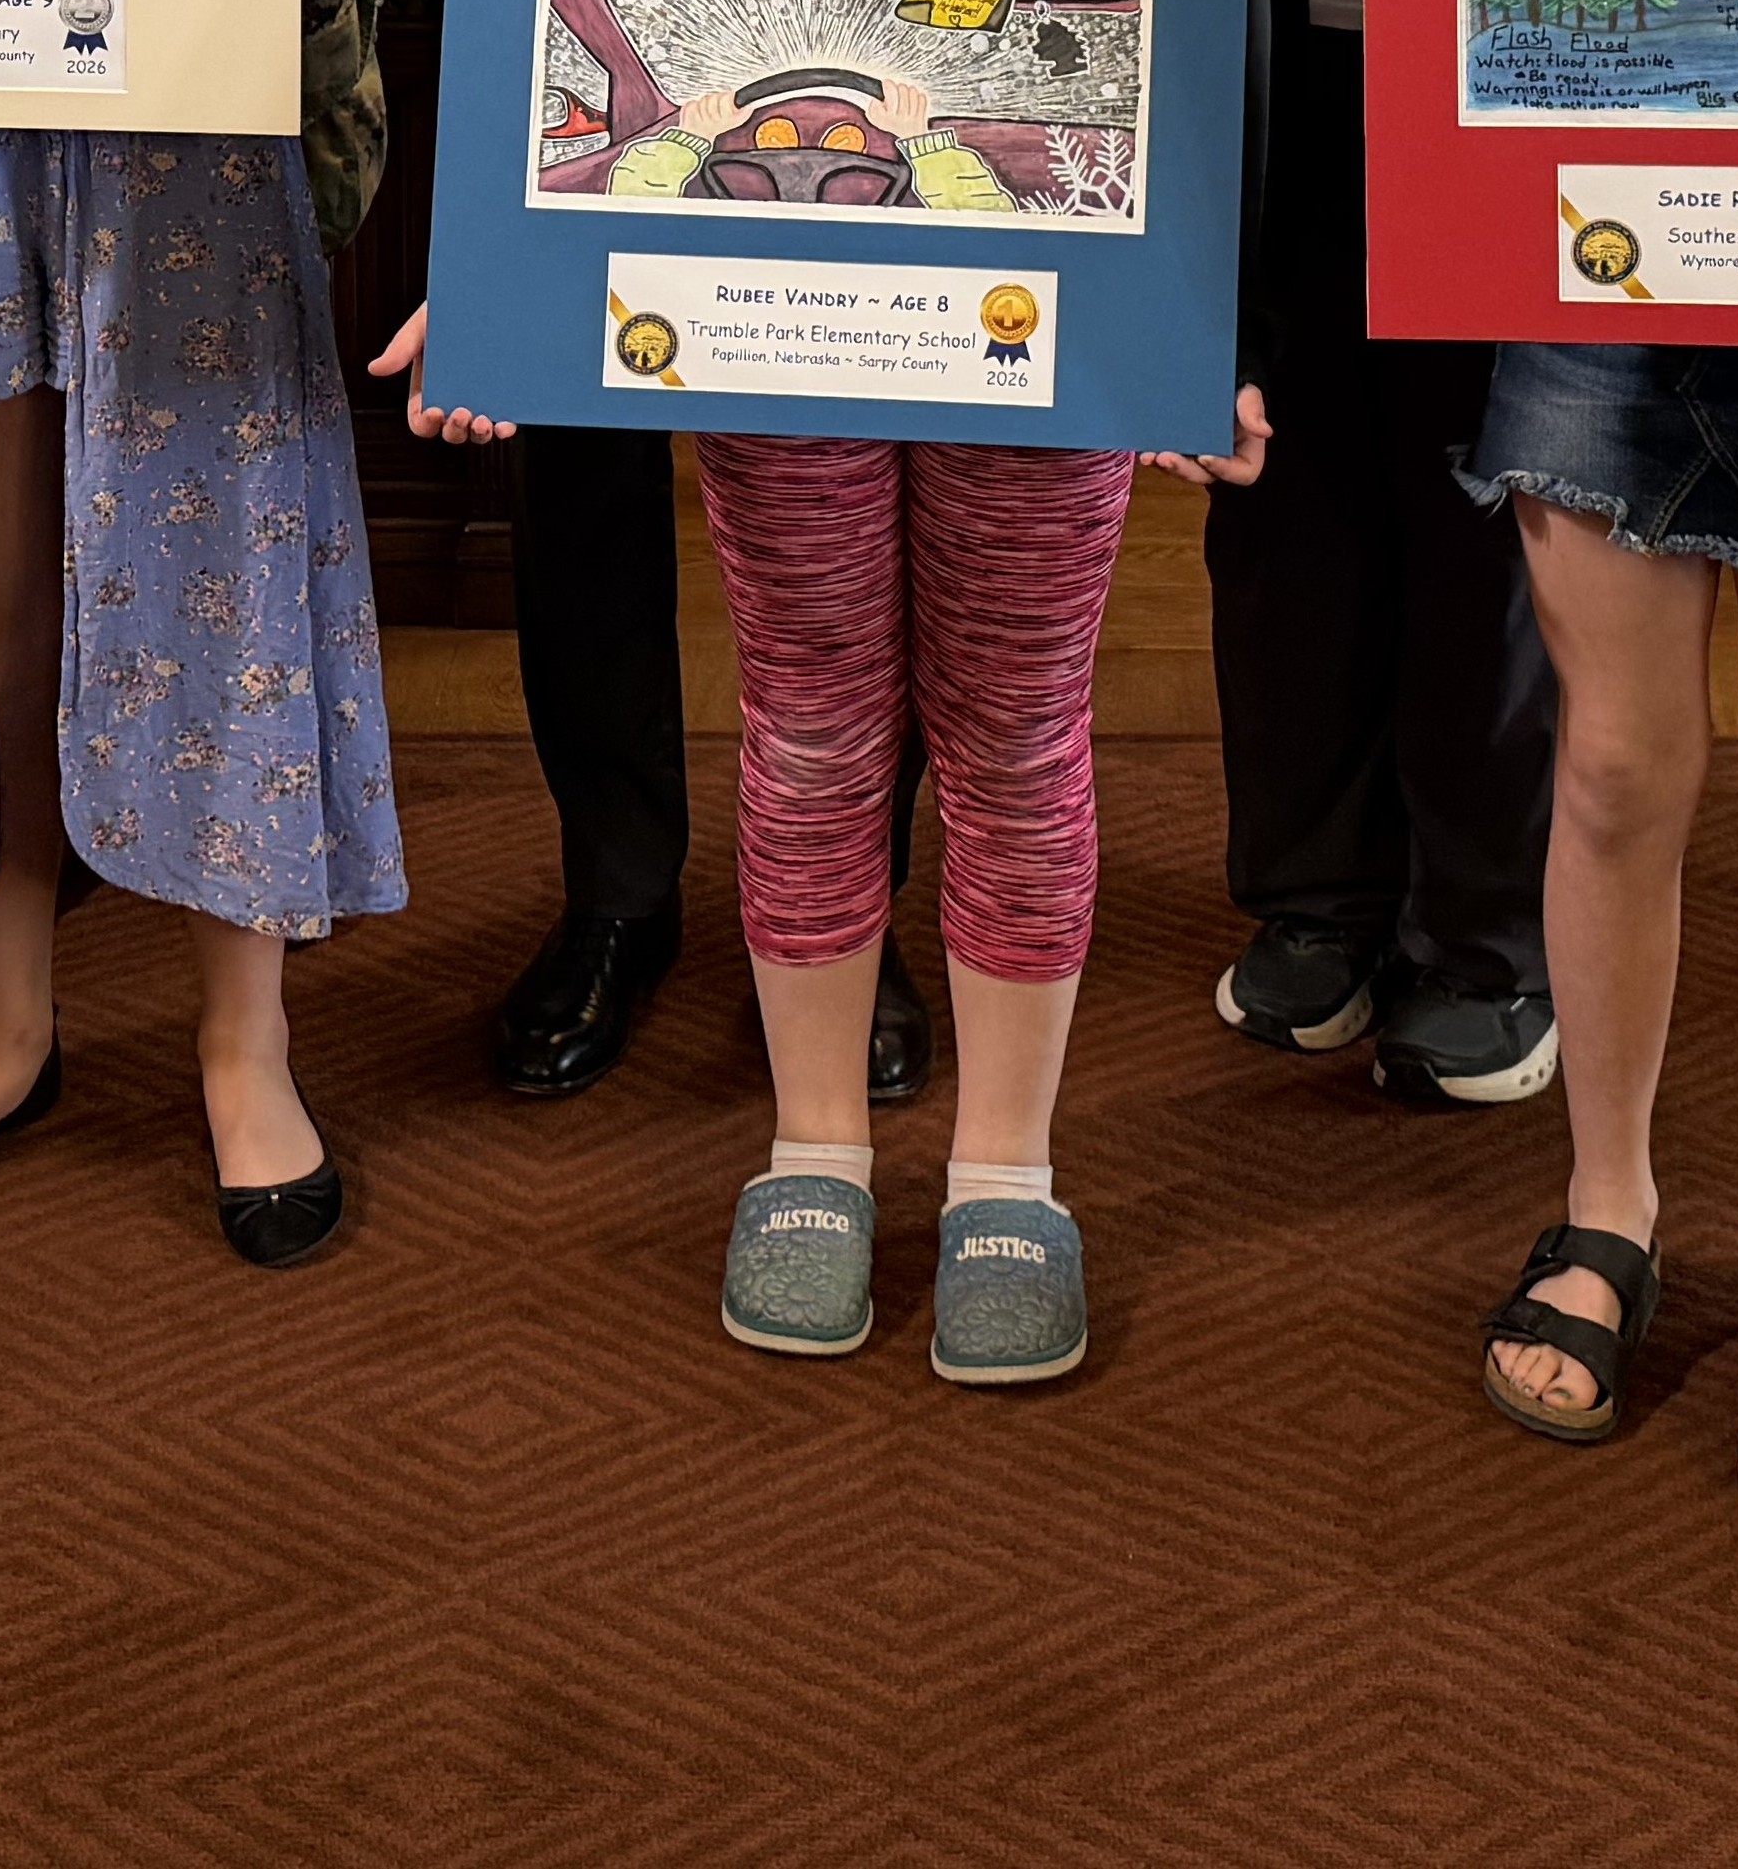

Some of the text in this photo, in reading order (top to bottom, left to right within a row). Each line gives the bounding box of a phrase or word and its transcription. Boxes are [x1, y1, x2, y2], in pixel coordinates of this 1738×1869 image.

[1490, 25, 1629, 51] Flash Flood
[66, 60, 107, 75] 2026
[1658, 189, 1722, 208] SADIE
[716, 284, 949, 313] RUBEE VANDRY AGE 8
[687, 319, 976, 350] Trumble Park Elementary School
[711, 347, 949, 375] Papillion, Nebraska Sarpy County
[986, 370, 1029, 388] 2026
